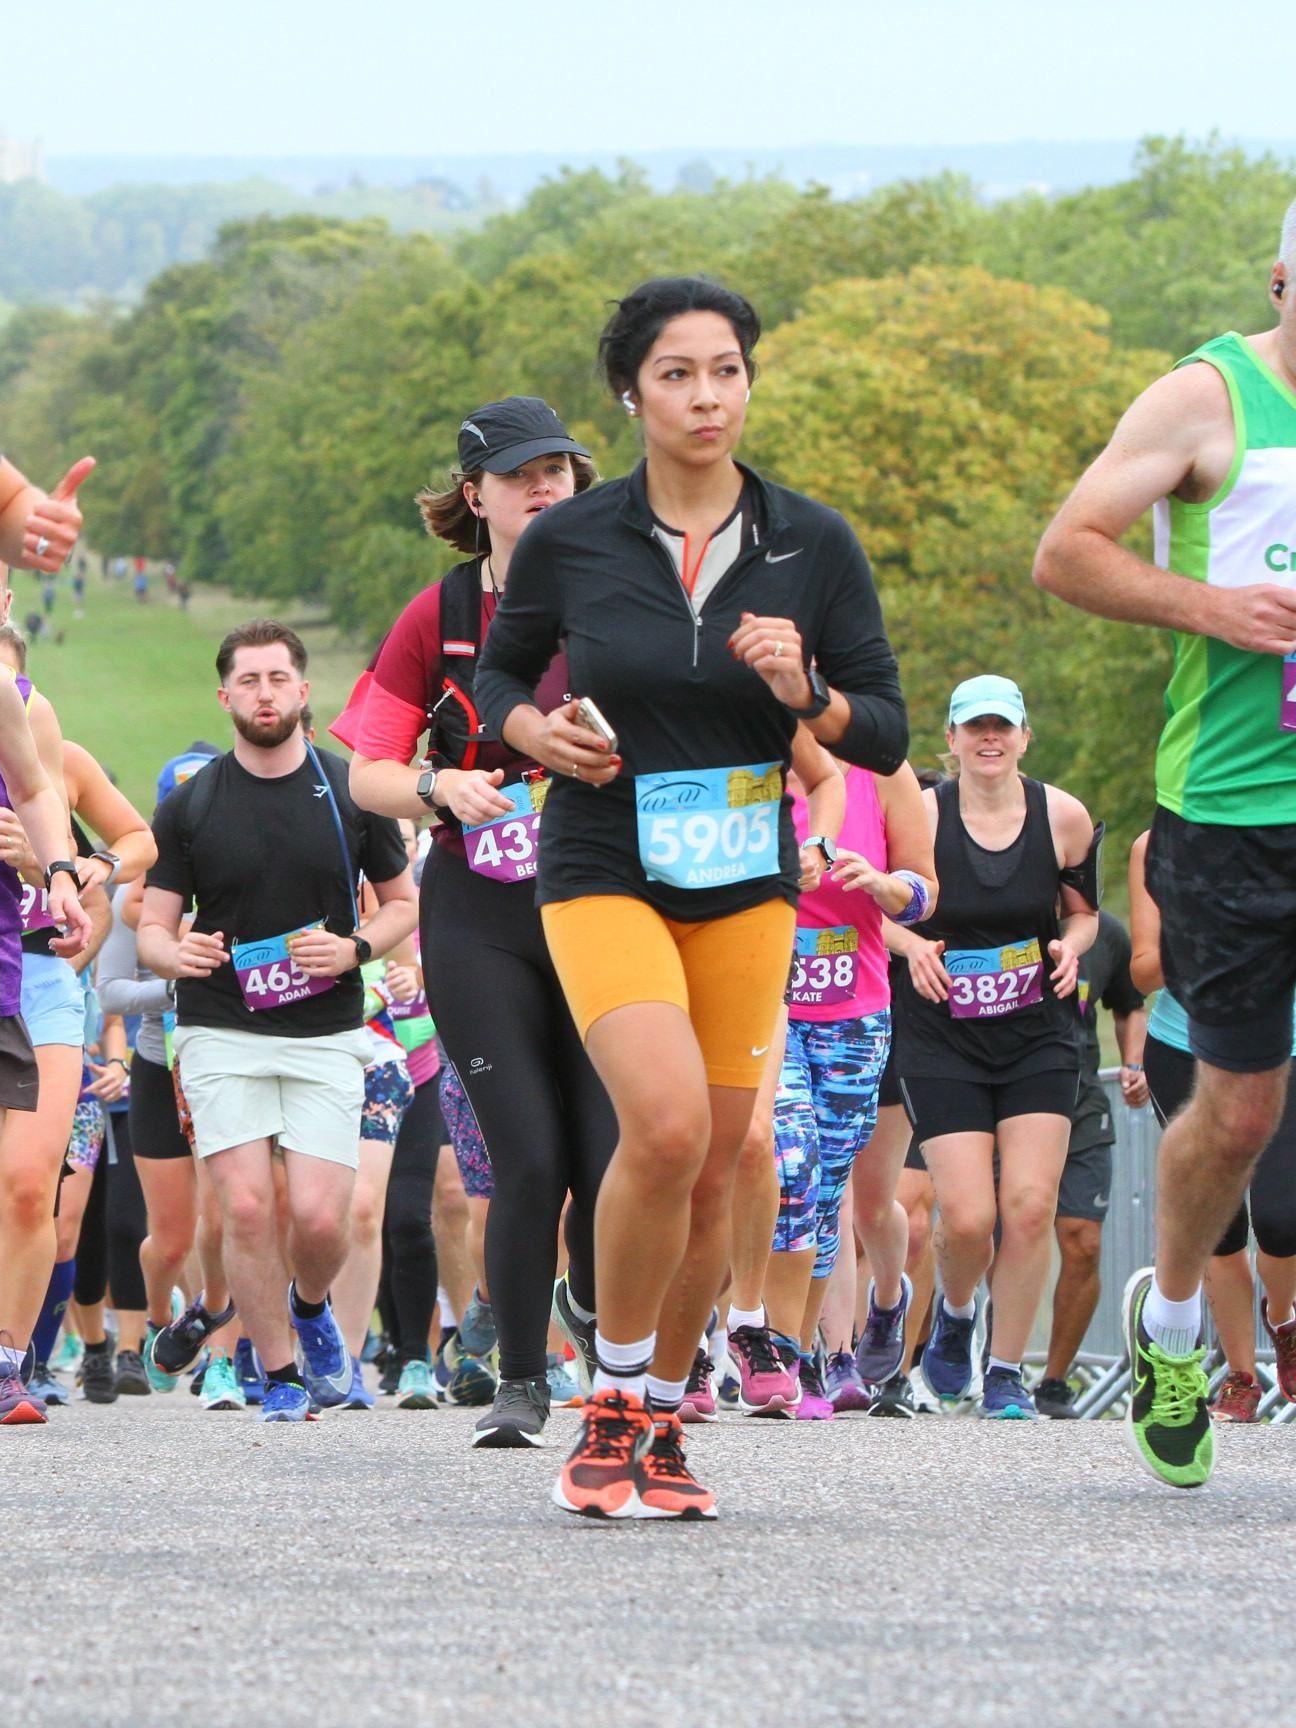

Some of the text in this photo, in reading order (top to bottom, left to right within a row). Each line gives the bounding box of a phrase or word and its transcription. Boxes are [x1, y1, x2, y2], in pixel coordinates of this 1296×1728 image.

[647, 806, 772, 865] 5905
[687, 862, 746, 883] ANDREA
[953, 965, 1039, 1005] 3827
[278, 986, 312, 1004] ADAM
[793, 991, 822, 1002] KATE
[978, 1000, 1019, 1016] ABIGAIL
